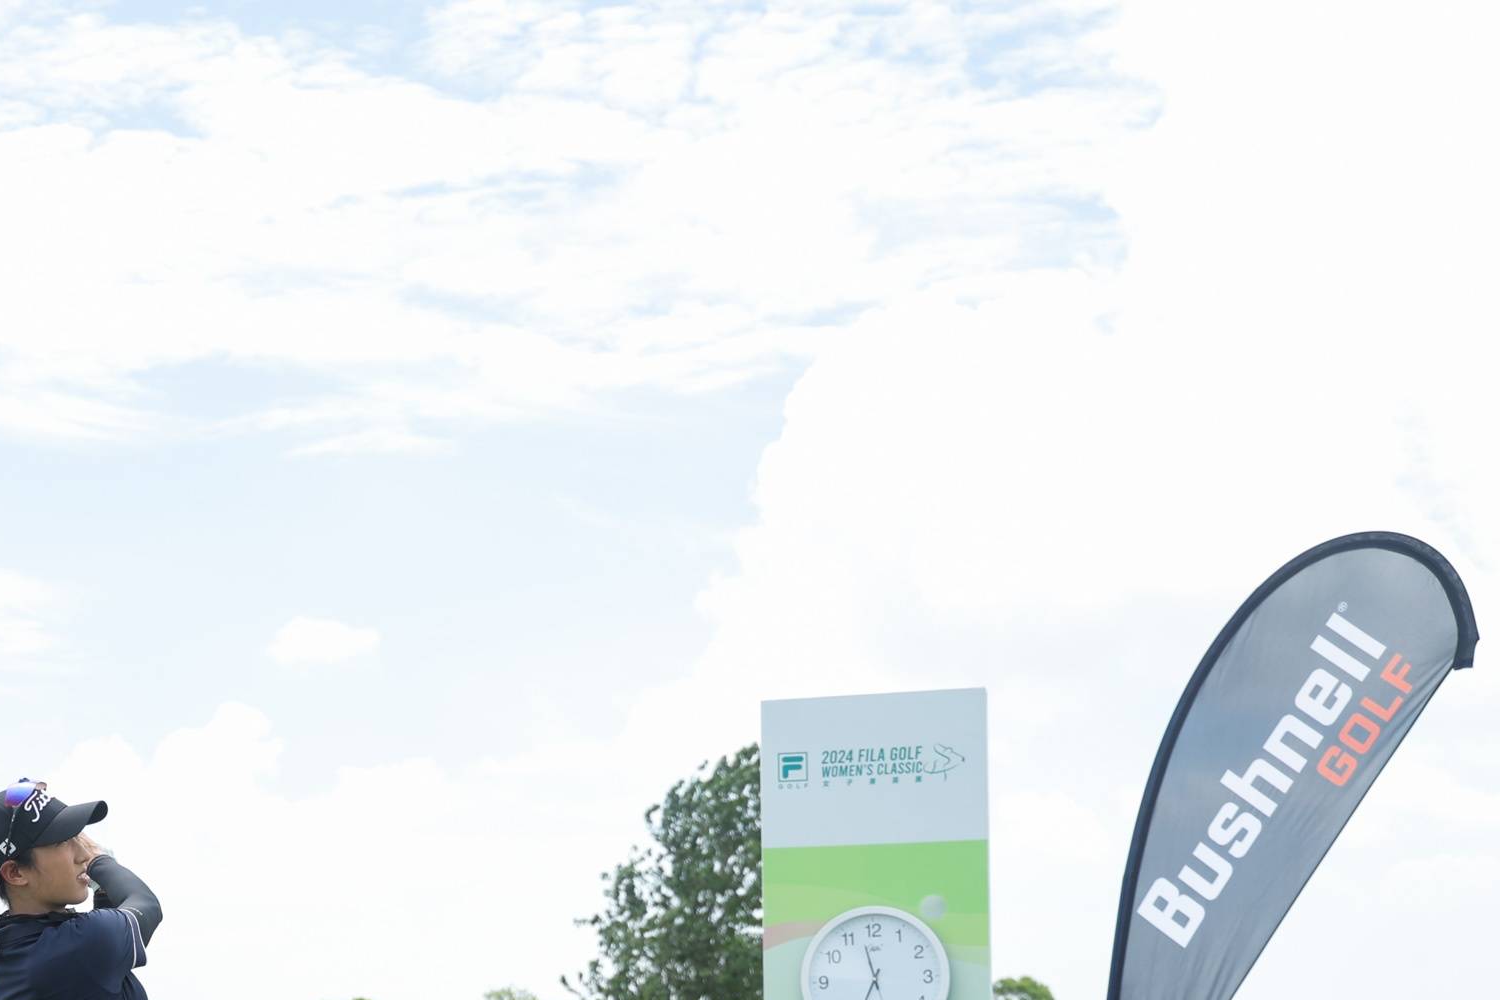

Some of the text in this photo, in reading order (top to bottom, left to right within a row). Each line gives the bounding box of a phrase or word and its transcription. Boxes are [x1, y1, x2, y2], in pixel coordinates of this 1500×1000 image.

[1316, 653, 1413, 787] GOLF
[821, 745, 923, 764] 2024 FILA GOLF
[821, 761, 923, 777] WOMEN'S CLASSIC
[865, 923, 882, 938] 12
[843, 932, 855, 946] 11
[826, 949, 842, 964] 10
[913, 944, 925, 959] 2
[818, 975, 829, 990] 9
[922, 969, 934, 984] 3
